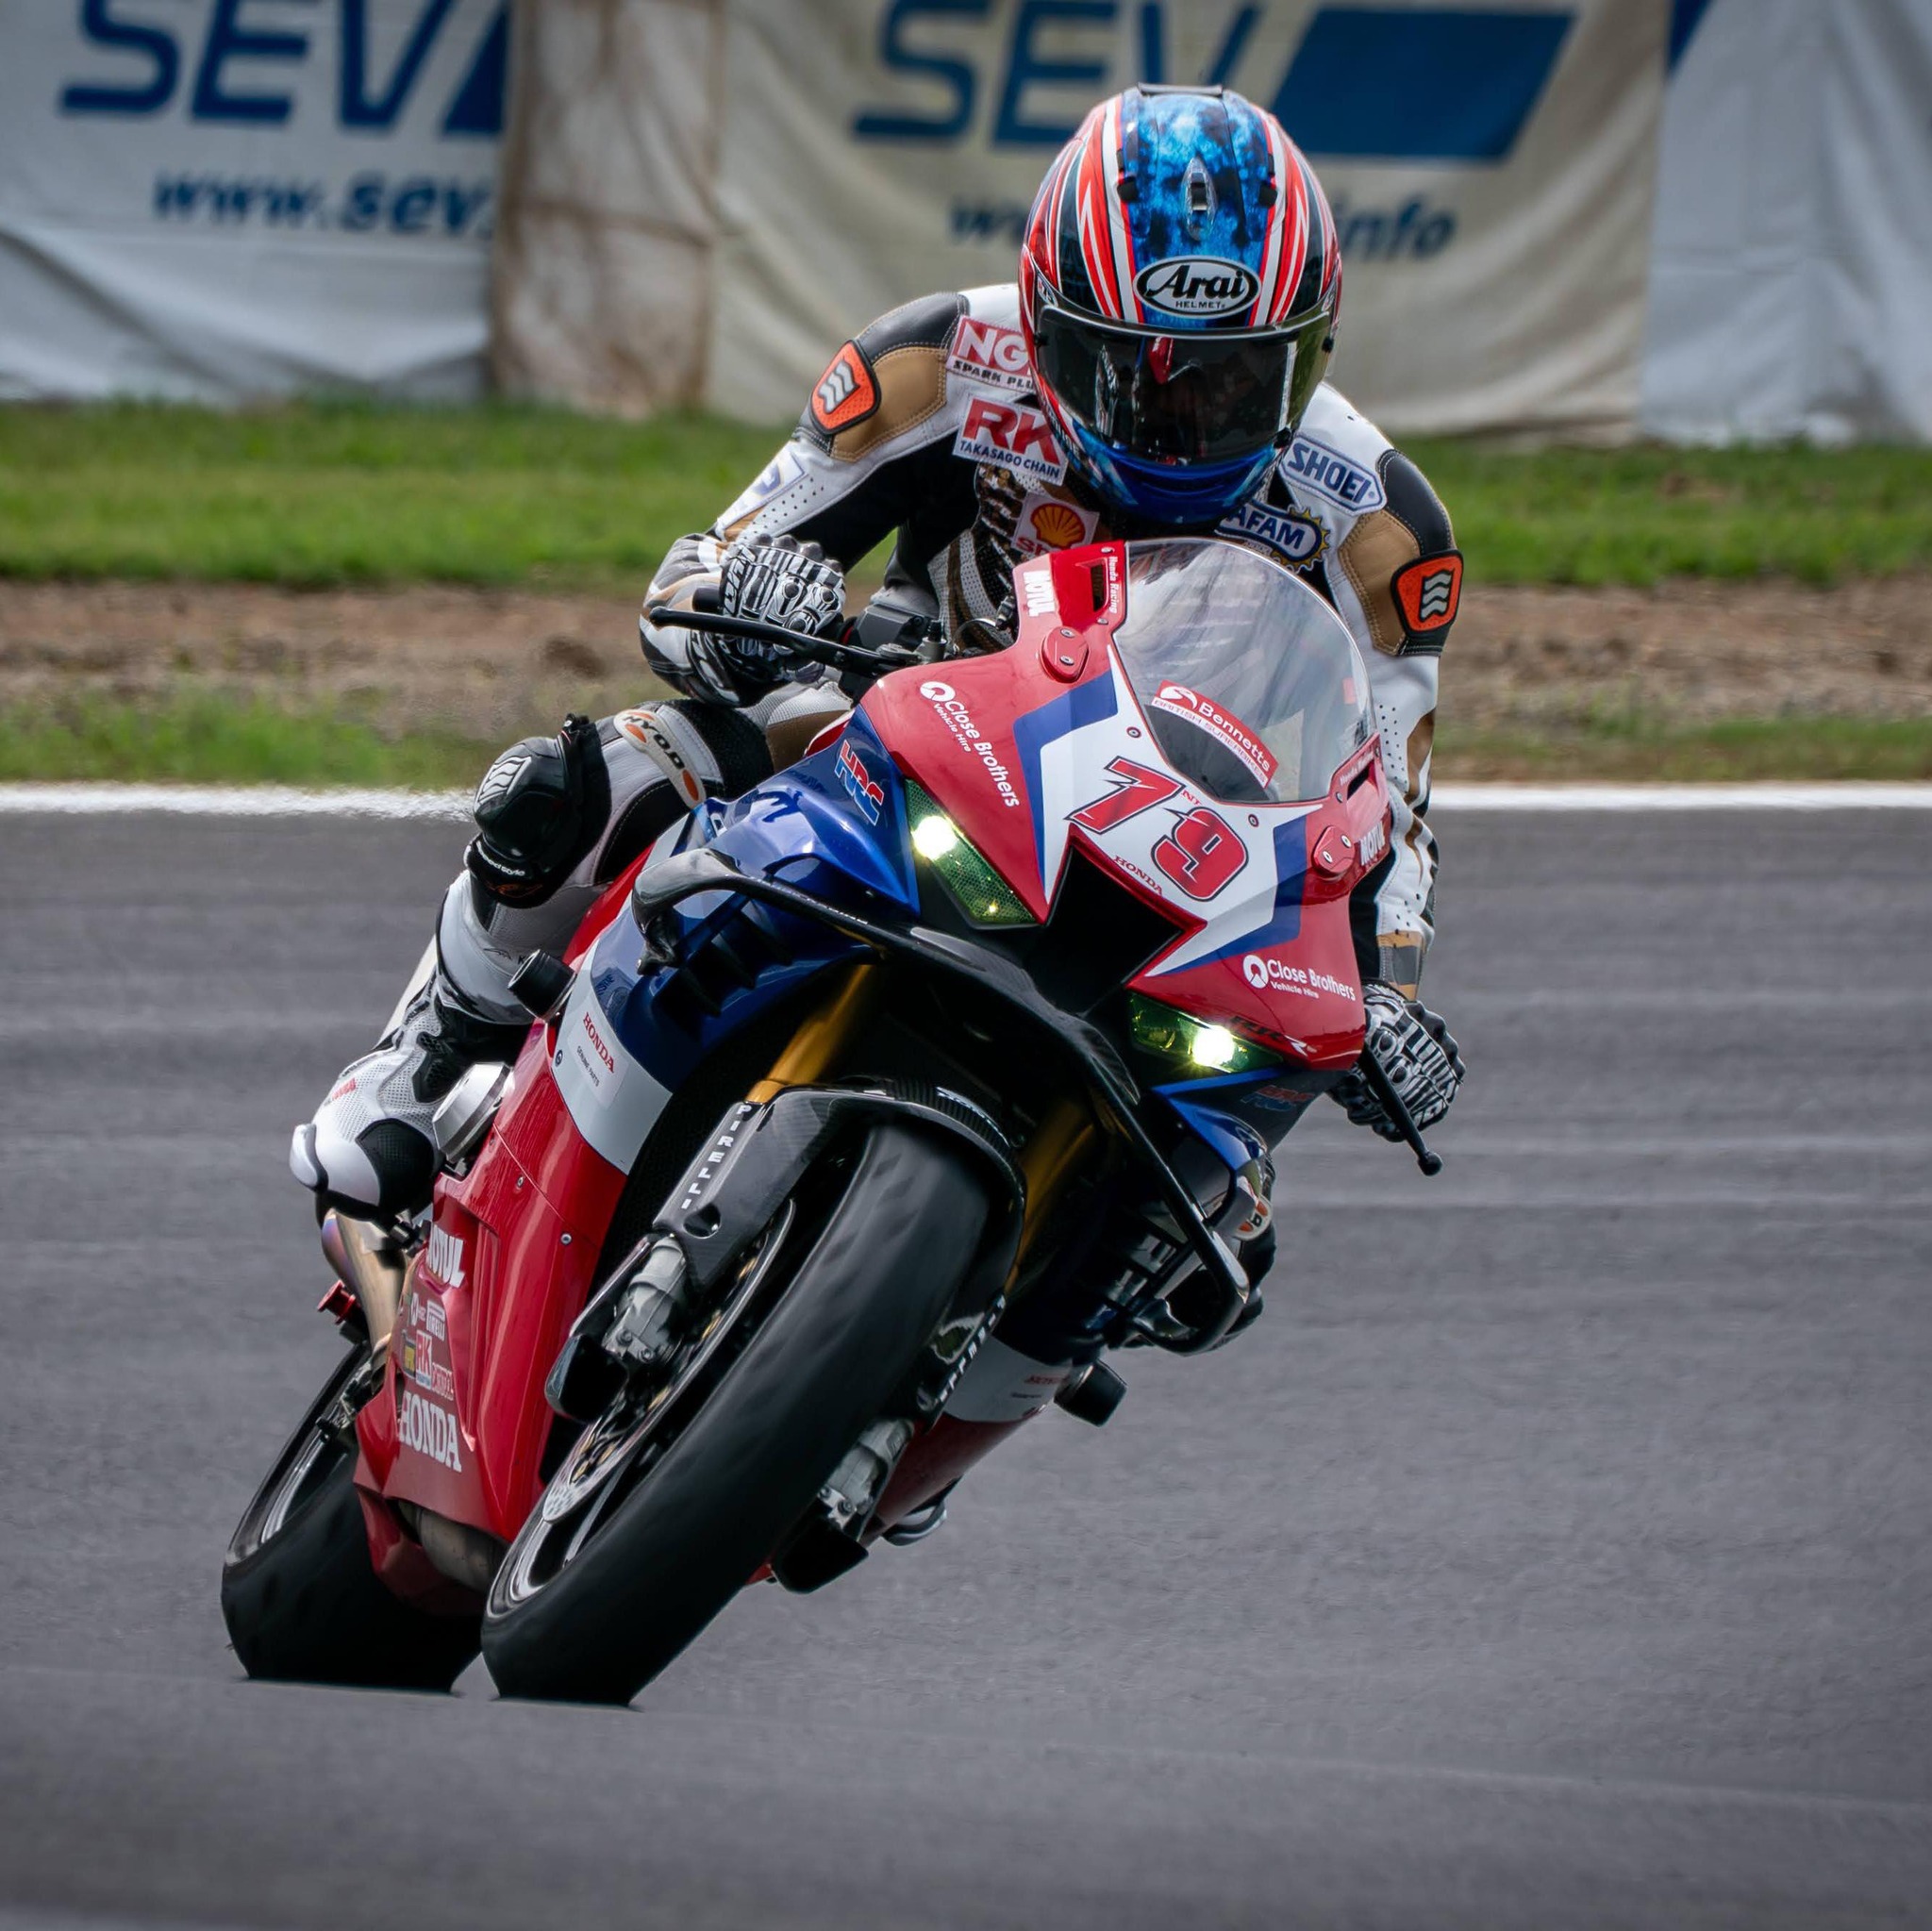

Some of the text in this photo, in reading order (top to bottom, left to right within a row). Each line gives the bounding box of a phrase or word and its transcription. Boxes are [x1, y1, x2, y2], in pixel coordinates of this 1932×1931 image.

[58, 0, 455, 133] SEV
[854, 0, 1261, 150] SEV
[1144, 265, 1245, 299] Arai
[1175, 301, 1224, 309] HELMET
[953, 360, 1035, 391] SPARK PLU
[957, 322, 1030, 374] NG
[960, 441, 1060, 479] TAKASAGO CHAIN
[962, 398, 1061, 466] RK
[1287, 442, 1372, 504] SHOEI
[1227, 507, 1307, 550] AFAM
[944, 701, 1020, 808] Close Brothers
[956, 733, 973, 753] Hire
[1198, 702, 1271, 773] Bennetts
[1063, 756, 1249, 902] 79
[1113, 856, 1163, 896] HONDA
[1267, 958, 1357, 1002] Close Brothers
[583, 1012, 614, 1074] HONDA
[681, 1105, 752, 1209] PIRELLI
[399, 1391, 462, 1473] HONDA
